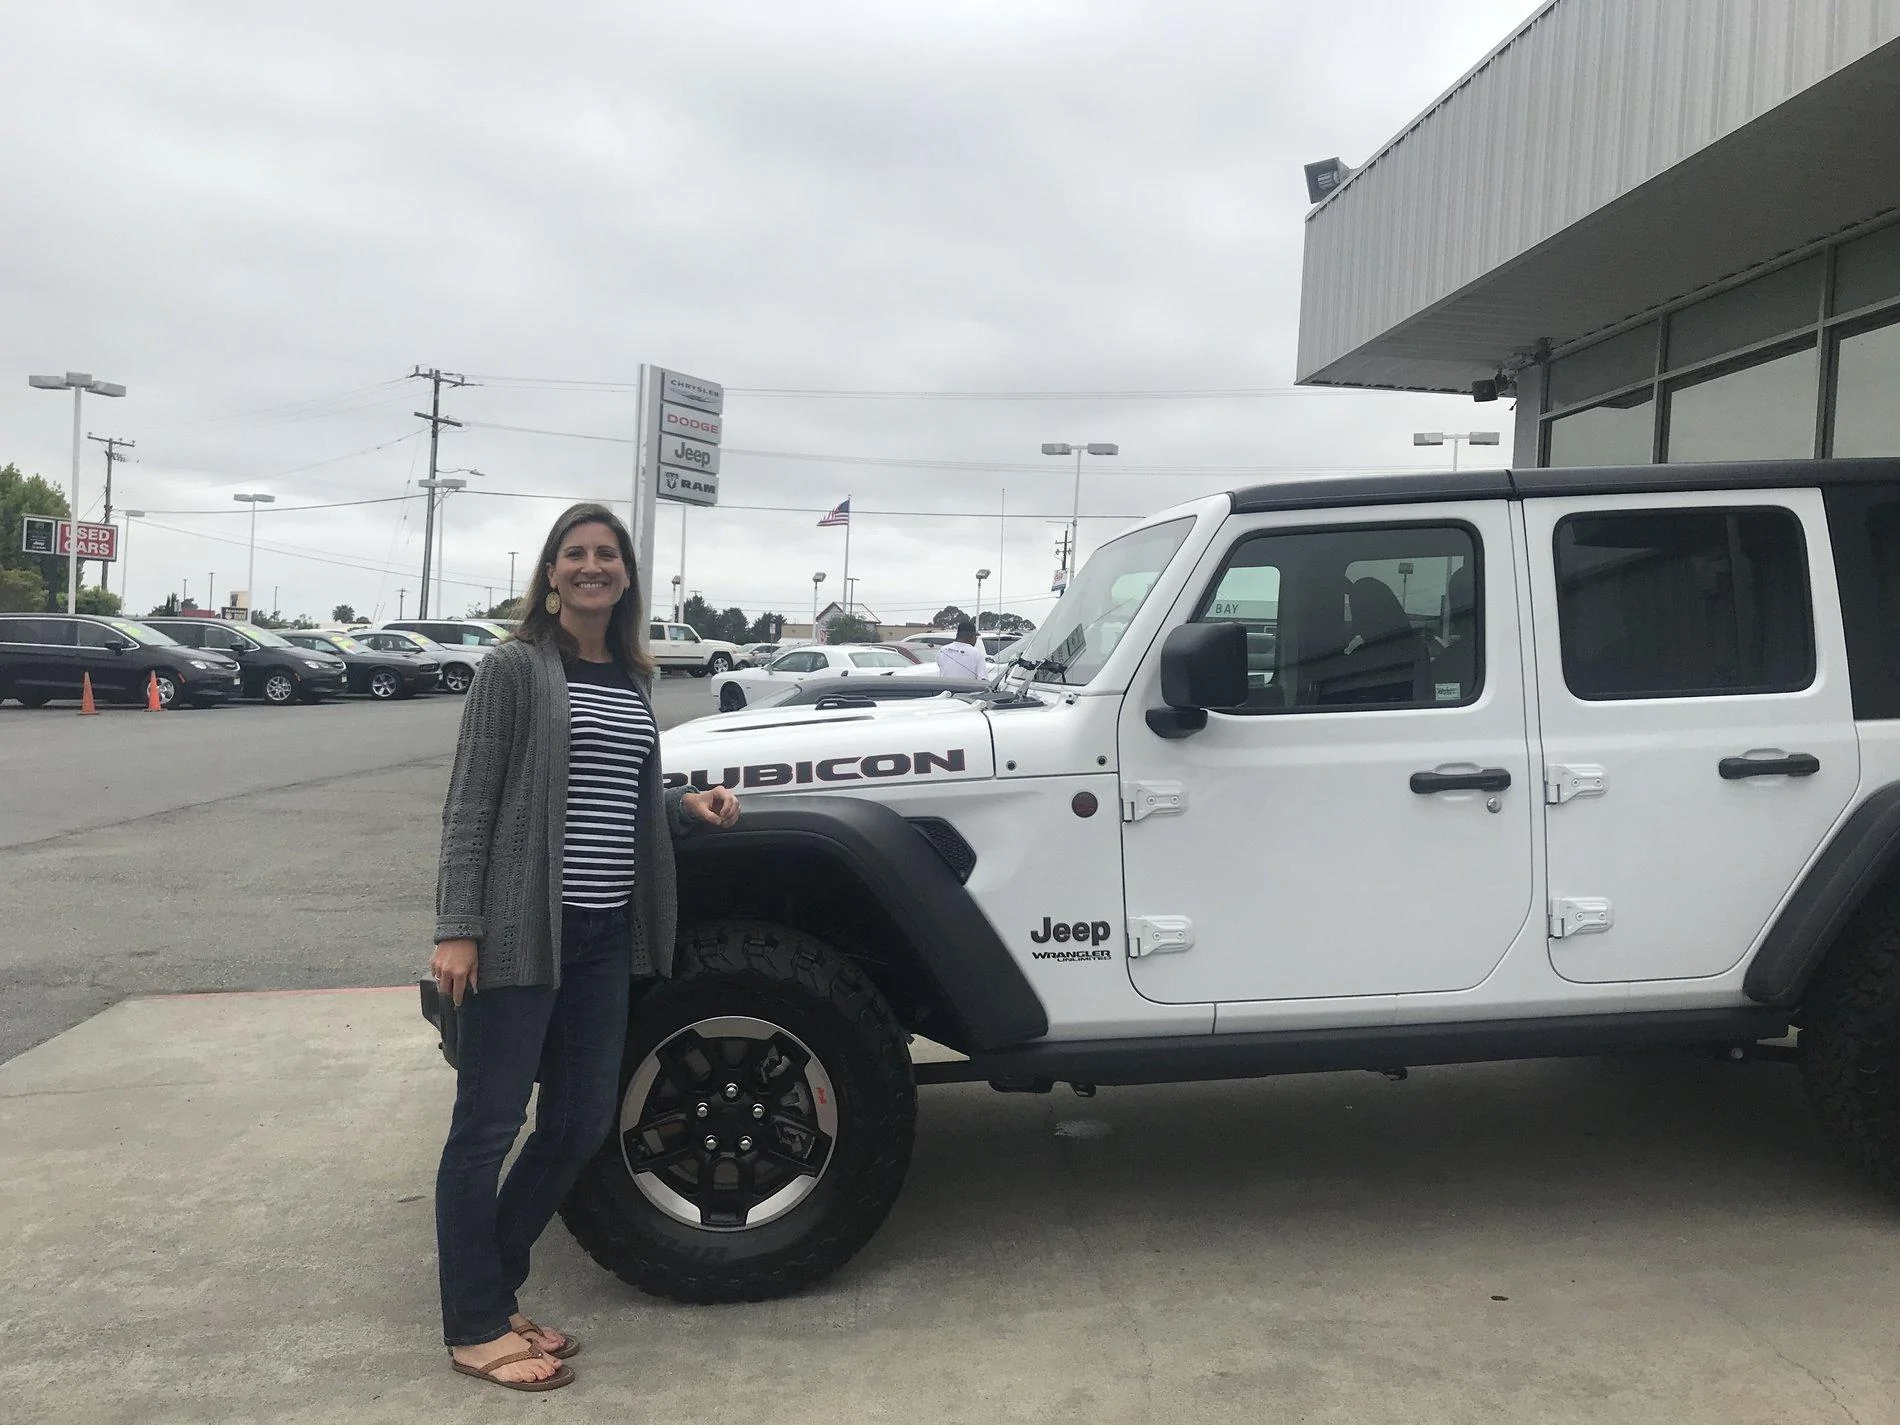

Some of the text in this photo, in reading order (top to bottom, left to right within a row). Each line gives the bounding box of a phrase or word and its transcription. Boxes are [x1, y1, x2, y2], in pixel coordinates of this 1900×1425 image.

[670, 379, 720, 398] CHRYSLER
[667, 414, 719, 434] DODGE
[674, 441, 710, 467] Jeep
[680, 479, 716, 494] RAM
[1215, 603, 1239, 614] BAY
[1030, 916, 1111, 946] Jeep
[1031, 949, 1111, 959] WRANGLER
